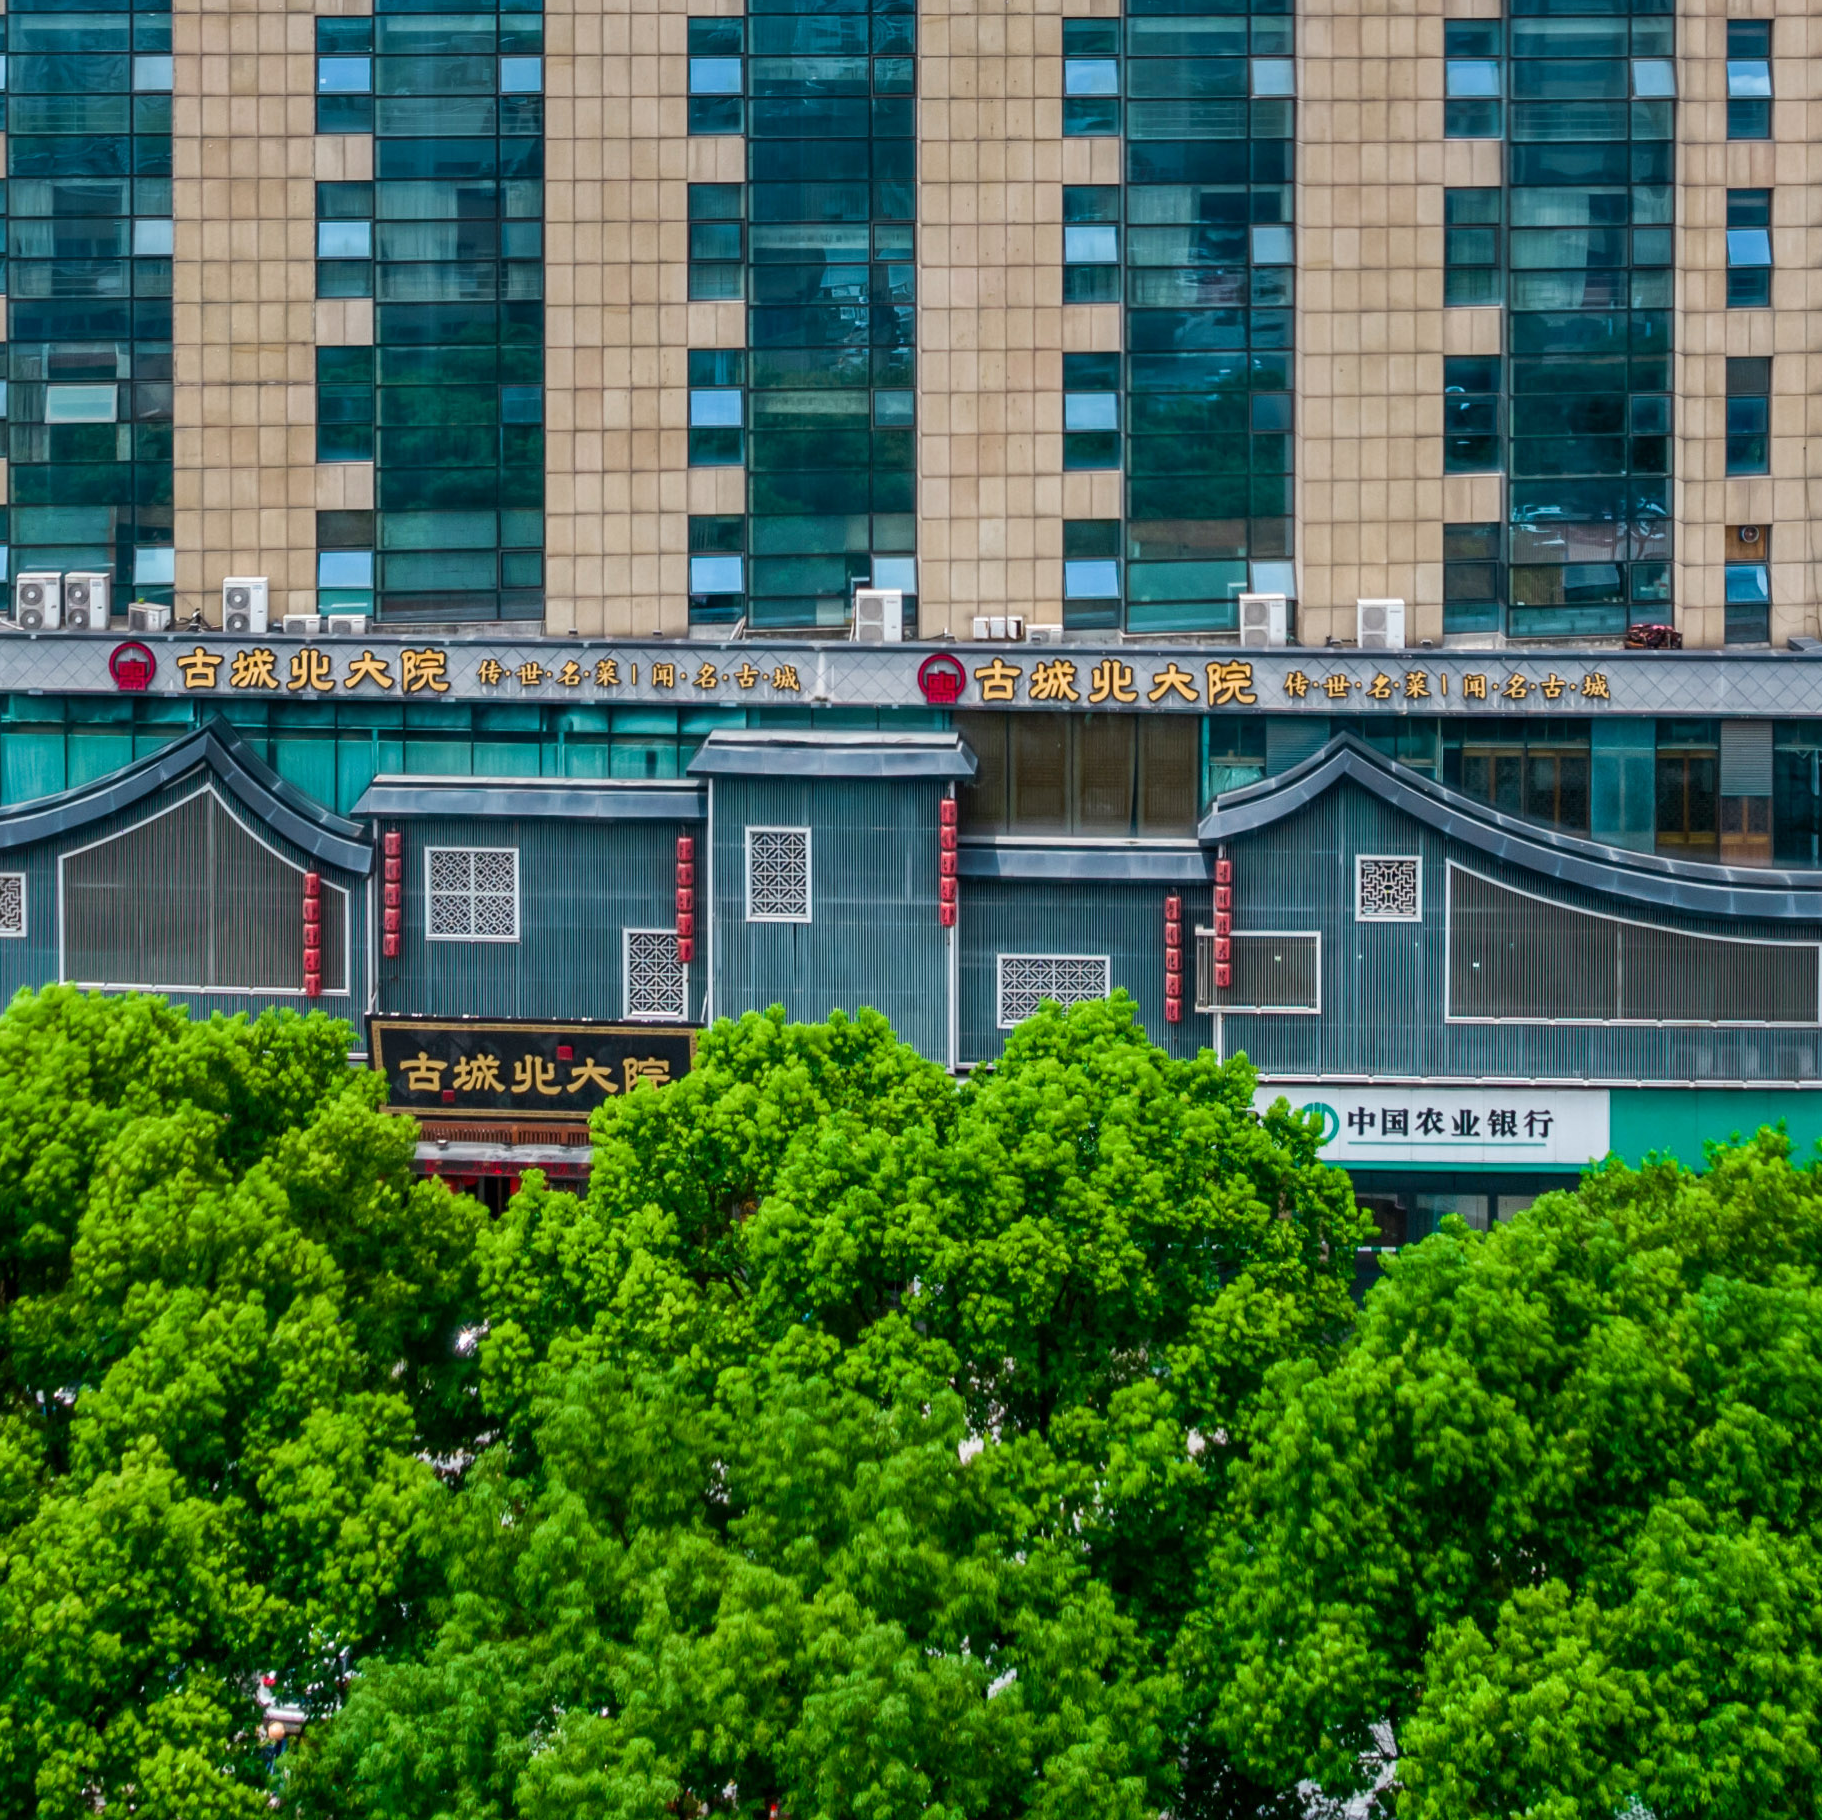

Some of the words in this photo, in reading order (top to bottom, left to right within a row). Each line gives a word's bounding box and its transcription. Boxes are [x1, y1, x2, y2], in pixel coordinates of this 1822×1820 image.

[177, 646, 451, 694] 古城北大院
[974, 658, 1258, 706] 古城北大院
[399, 1051, 671, 1095] 古城北大院
[1347, 1105, 1554, 1139] 中国农业银行
